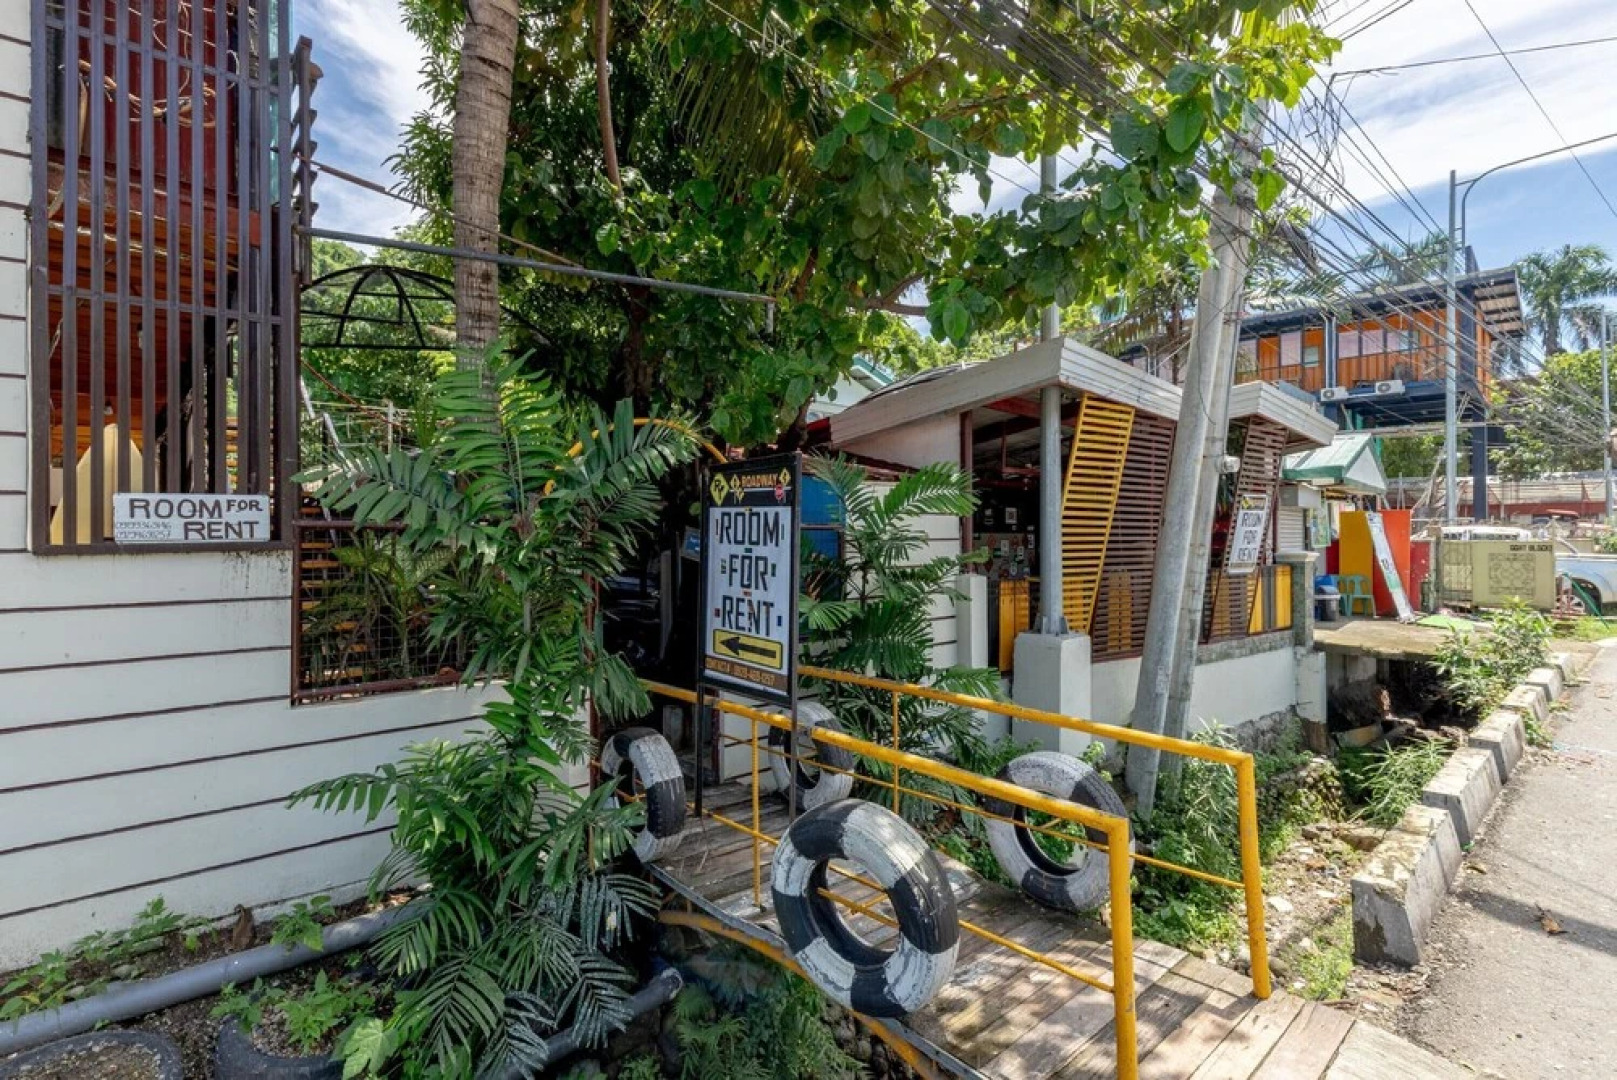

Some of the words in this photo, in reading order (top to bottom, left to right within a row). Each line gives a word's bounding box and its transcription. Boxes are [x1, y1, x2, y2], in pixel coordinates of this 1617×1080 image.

[741, 474, 778, 488] ROADWAY
[128, 497, 223, 520] ROOM
[226, 499, 264, 513] FOR
[1241, 511, 1262, 528] ROOM
[183, 520, 260, 541] RENT
[719, 511, 779, 548] ROOM
[728, 554, 769, 592] FOR
[721, 594, 775, 637] RENT
